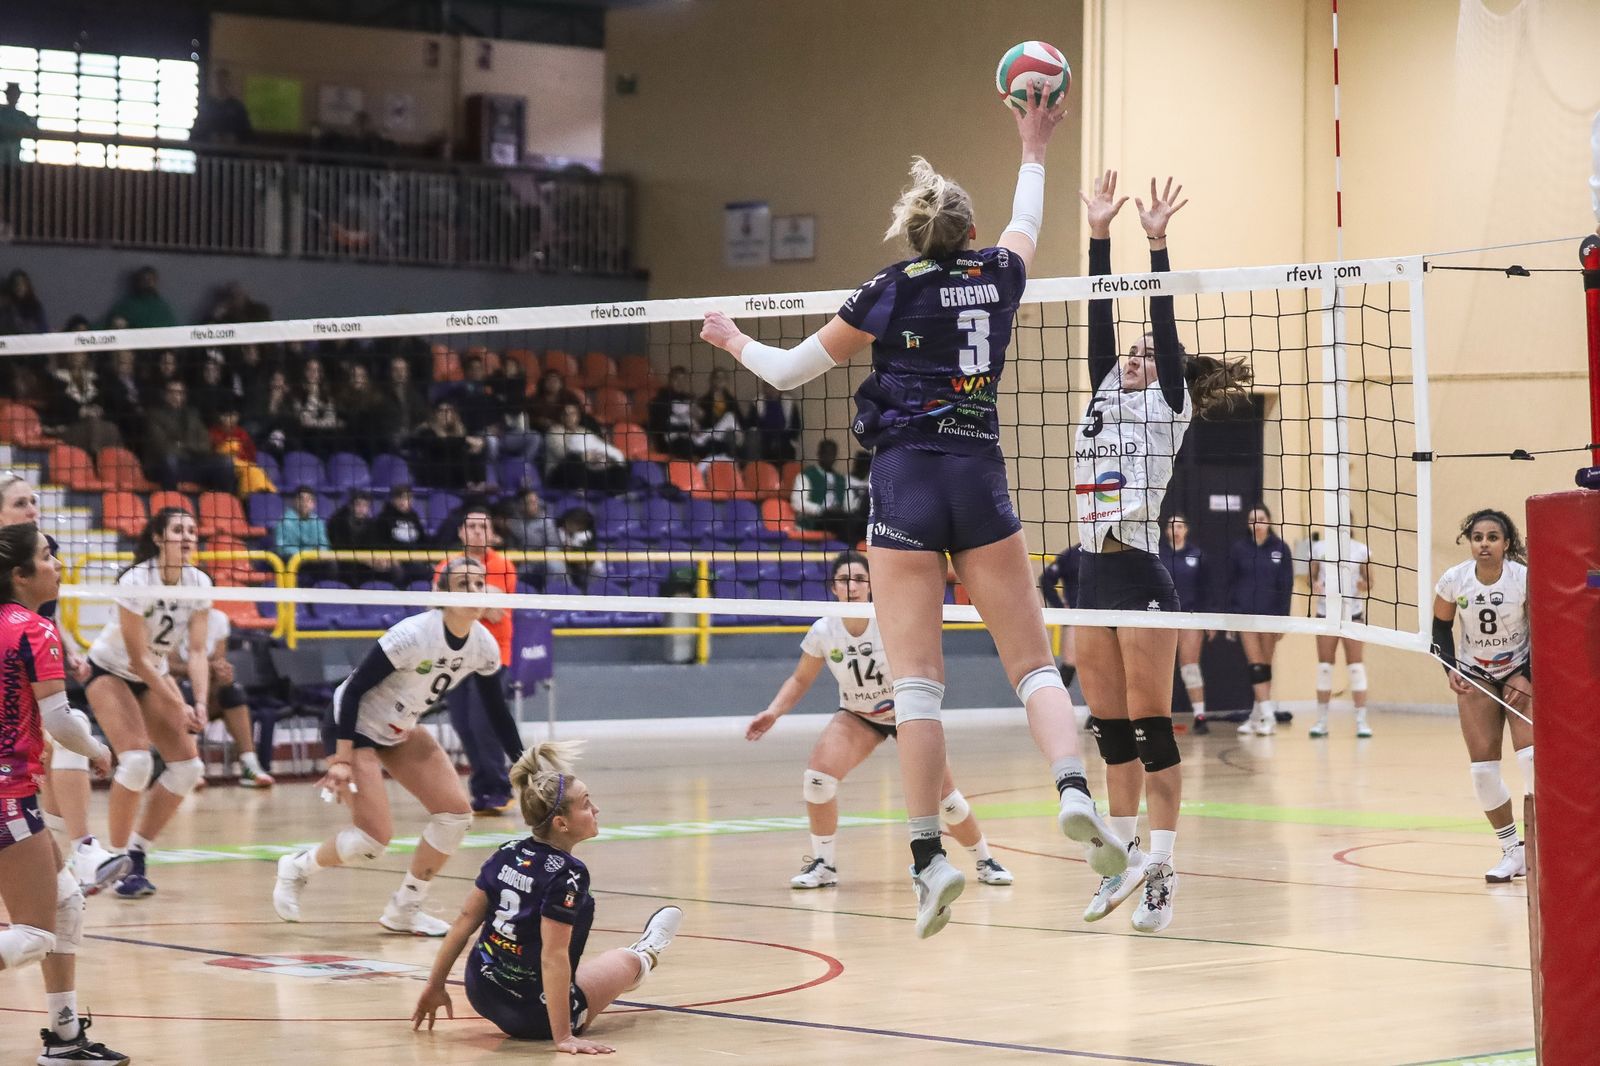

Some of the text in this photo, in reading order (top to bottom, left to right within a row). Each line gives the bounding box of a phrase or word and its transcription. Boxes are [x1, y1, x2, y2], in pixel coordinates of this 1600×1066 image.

[940, 283, 1000, 308] CERCHIO
[1092, 277, 1161, 293] rfevb.com
[590, 305, 646, 320] rfevb.com
[745, 297, 804, 312] rfevb.com
[313, 319, 362, 334] rfevb.com
[446, 313, 499, 327] rfevb.com
[957, 309, 992, 376] 3
[1082, 397, 1108, 438] 5
[153, 615, 174, 646] 2
[1478, 608, 1498, 635] 8
[1475, 632, 1519, 648] MADRID
[847, 658, 884, 687] 14
[425, 672, 452, 705] 9
[854, 685, 895, 701] MADRI
[492, 888, 521, 941] 2
